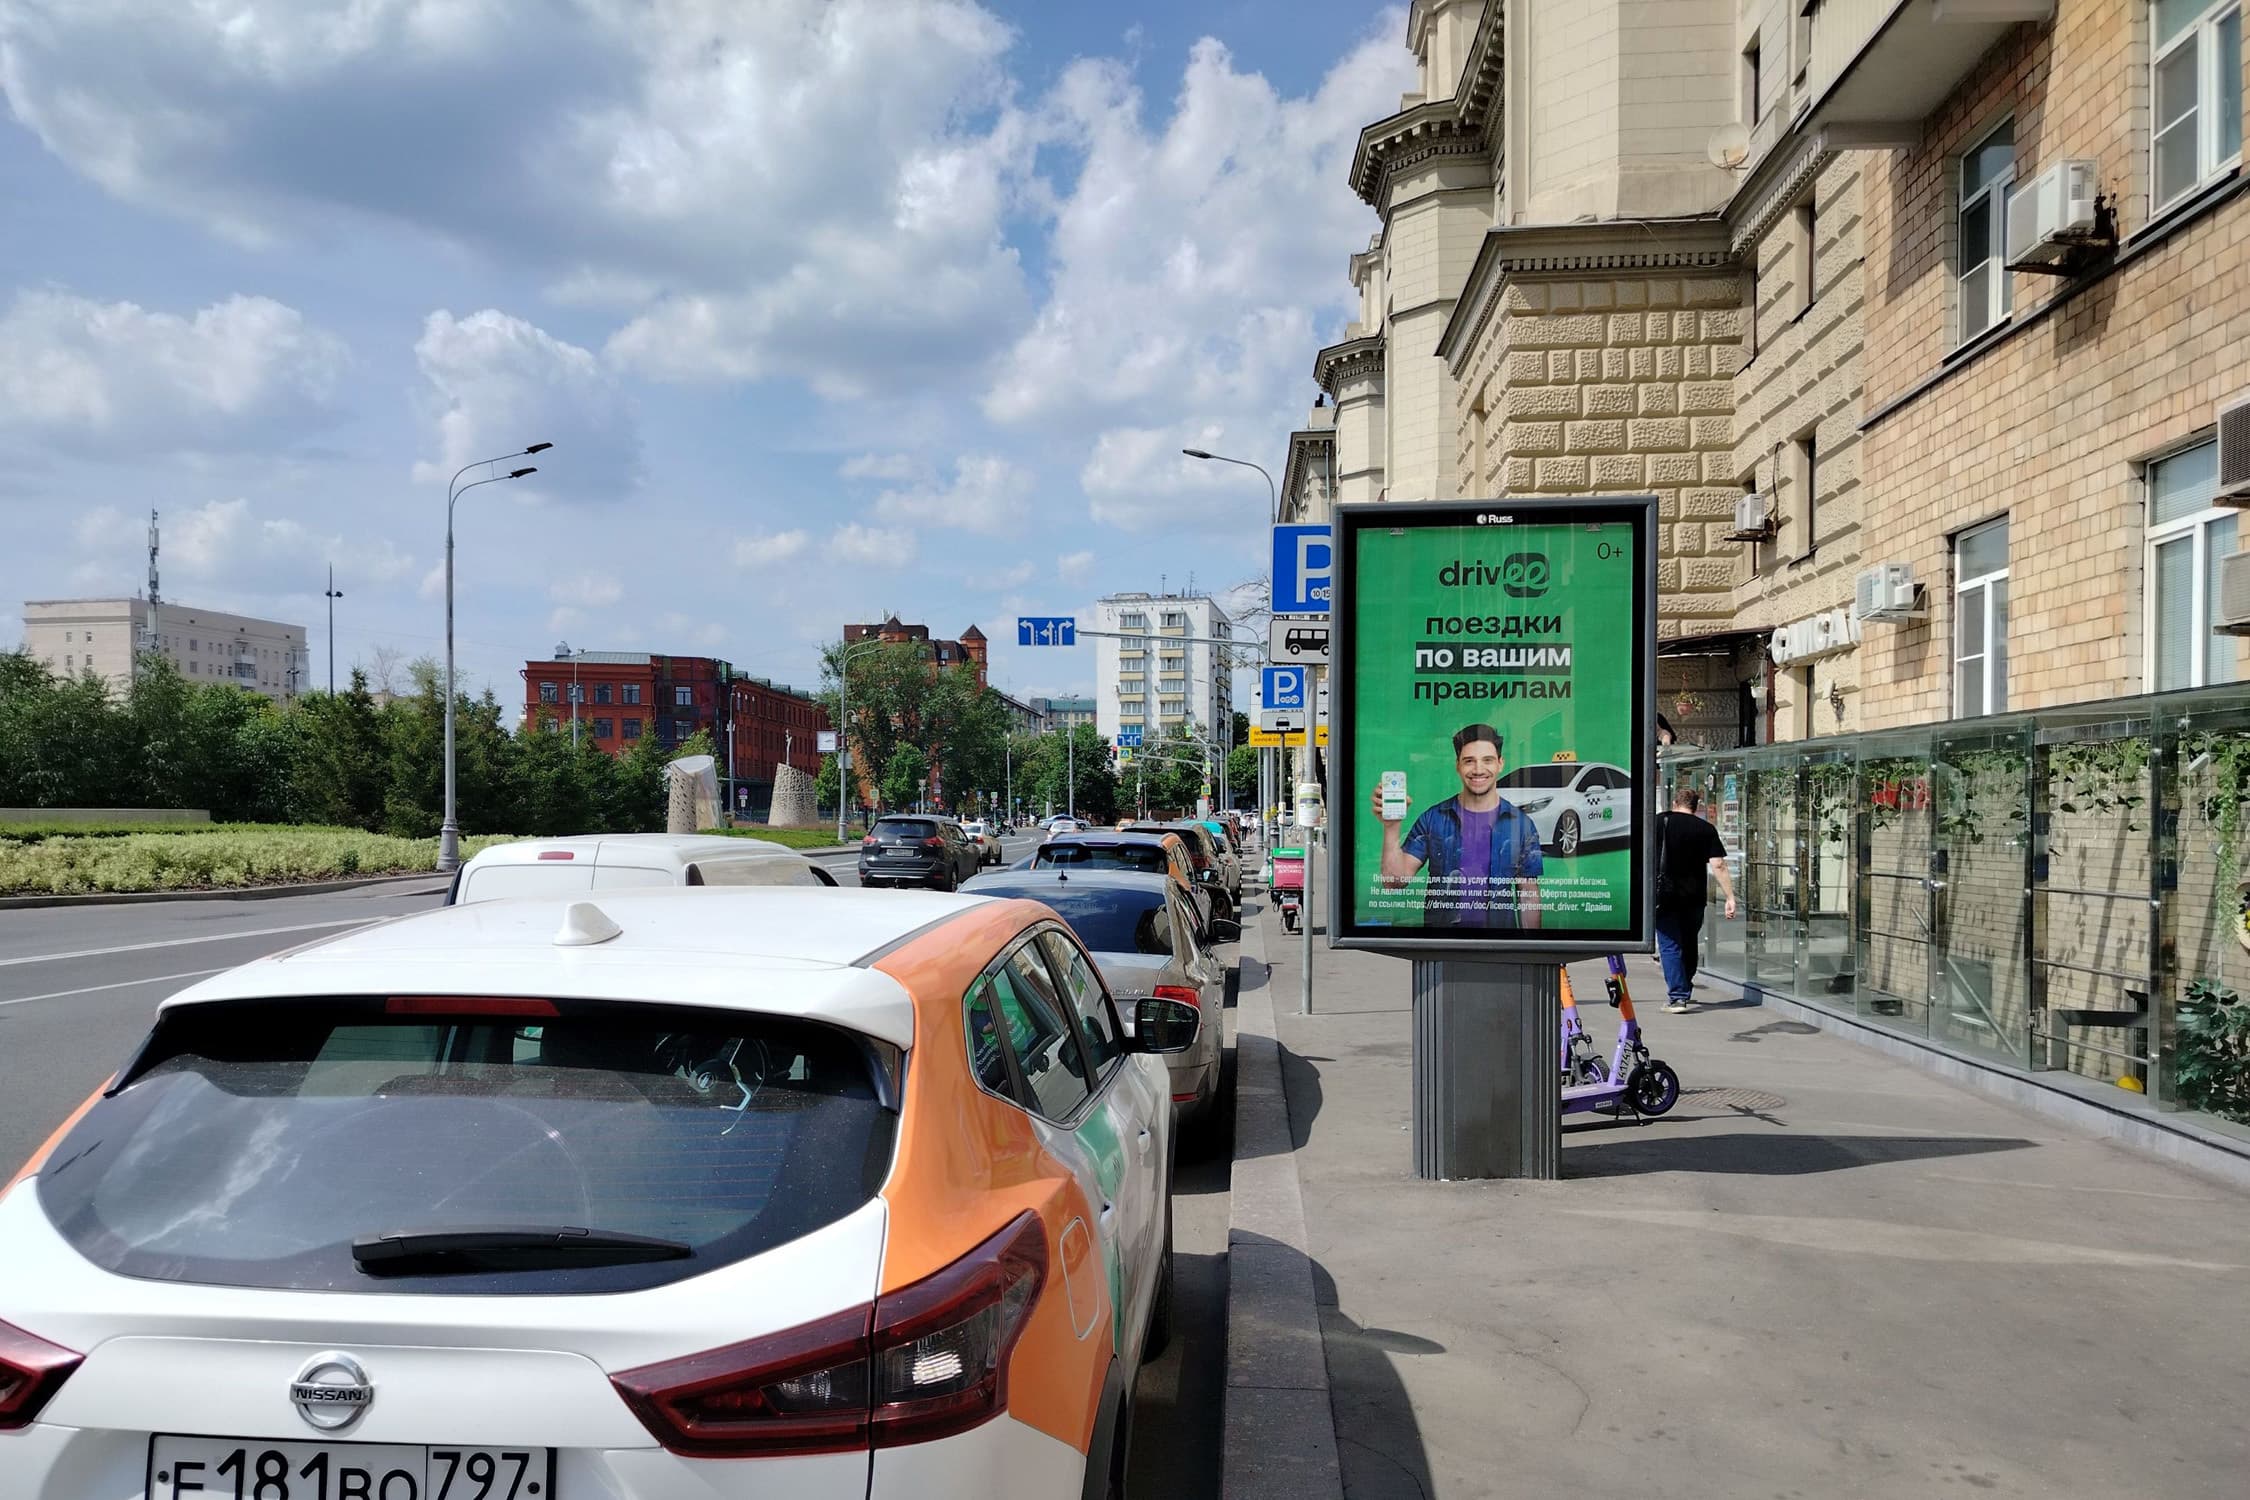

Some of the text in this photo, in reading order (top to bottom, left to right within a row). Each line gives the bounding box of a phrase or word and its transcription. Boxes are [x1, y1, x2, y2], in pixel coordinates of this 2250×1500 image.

[1488, 514, 1513, 524] Russ
[1596, 542, 1623, 560] 0+
[1296, 534, 1332, 603] P
[1438, 554, 1551, 594] drivee
[1426, 615, 1562, 638] поездки
[1415, 646, 1571, 668] по вашим
[1273, 671, 1298, 705] P
[1414, 680, 1571, 706] правилам
[1373, 874, 1394, 883] Drivee
[1400, 876, 1425, 885] сервис
[1426, 876, 1440, 885] для
[1442, 876, 1466, 884] заказа
[1467, 876, 1488, 886] услуг
[1489, 877, 1527, 886] перевозки
[1370, 886, 1380, 896] Не
[1381, 888, 1414, 896] является
[1415, 889, 1467, 898] перевозчиком
[1468, 889, 1482, 897] или
[1483, 888, 1515, 898] службой
[1540, 888, 1567, 900] Оферта
[1379, 900, 1405, 909] ссылке
[296, 1388, 362, 1401] NISSAN
[432, 1451, 530, 1500] 797
